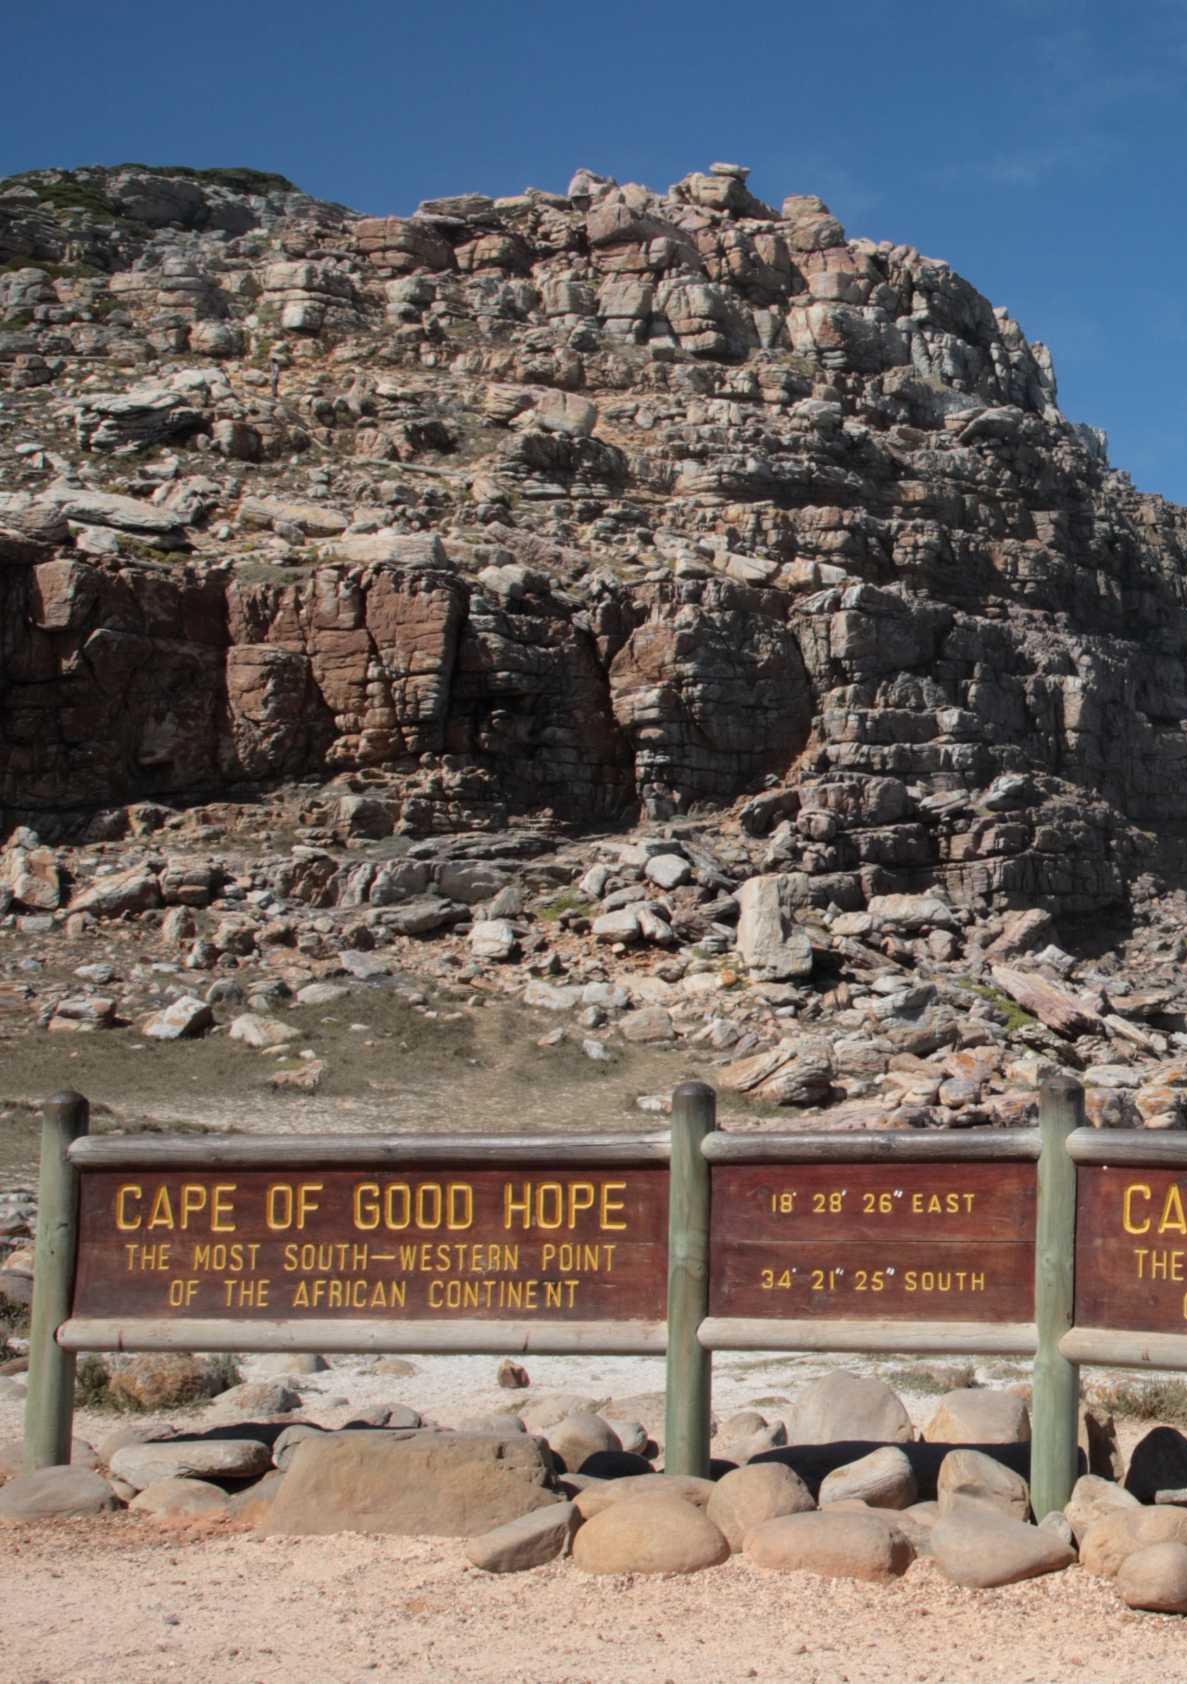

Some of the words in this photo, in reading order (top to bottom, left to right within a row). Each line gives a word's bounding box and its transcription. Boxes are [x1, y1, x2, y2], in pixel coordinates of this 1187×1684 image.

[116, 1182, 237, 1232] CAPE
[266, 1182, 324, 1231] OF
[354, 1182, 473, 1231] GOOD
[504, 1181, 627, 1231] HOPE
[912, 1193, 976, 1214] EAST
[125, 1243, 172, 1271] THE
[193, 1243, 261, 1272] MOST
[542, 1243, 617, 1272] POINT
[1133, 1248, 1185, 1282] THE
[169, 1279, 200, 1307] OF
[223, 1279, 270, 1307] THE
[292, 1279, 406, 1308] AFRICAN
[428, 1279, 580, 1309] CONTINENT
[904, 1271, 985, 1292] SOUTH
